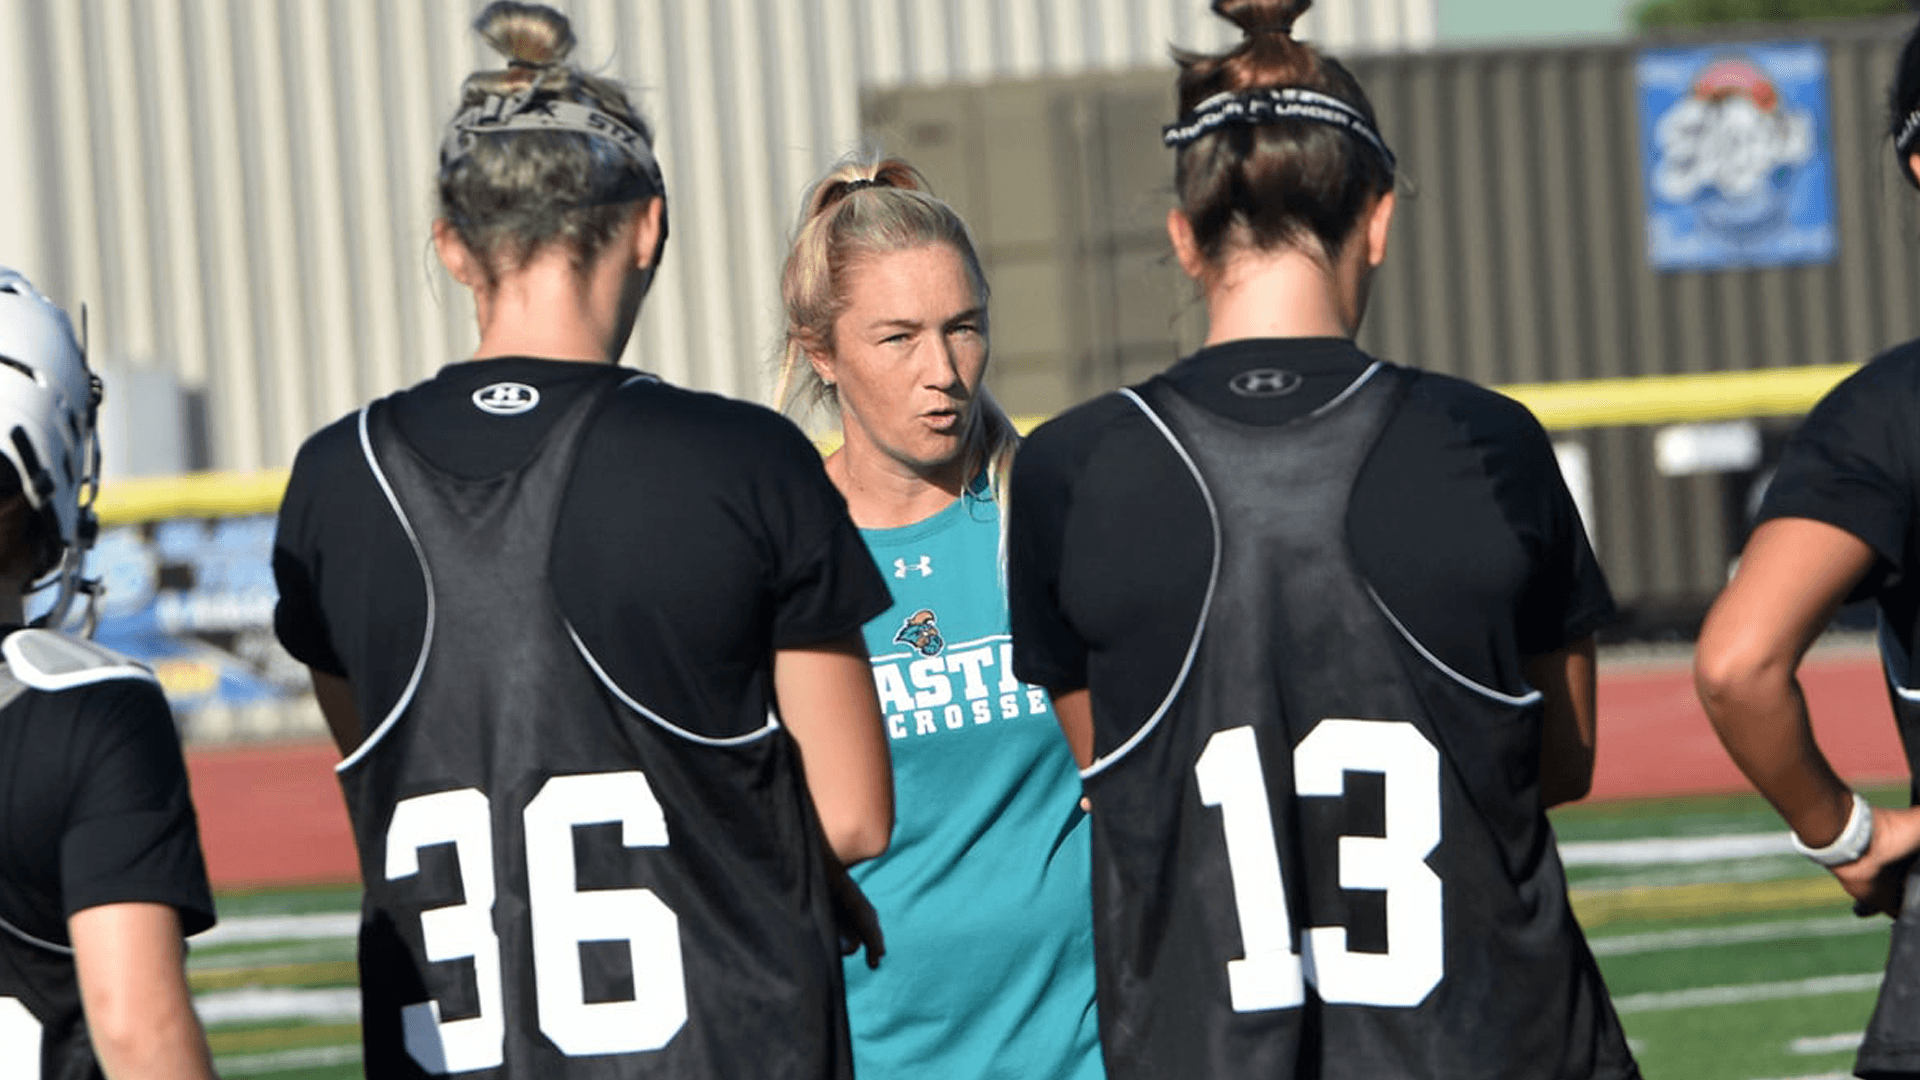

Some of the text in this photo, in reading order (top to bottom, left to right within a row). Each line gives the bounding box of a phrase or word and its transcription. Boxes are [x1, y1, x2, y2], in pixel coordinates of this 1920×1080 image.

[888, 689, 1046, 739] CROSSE
[385, 770, 689, 1075] 36
[1195, 718, 1444, 1012] 13
